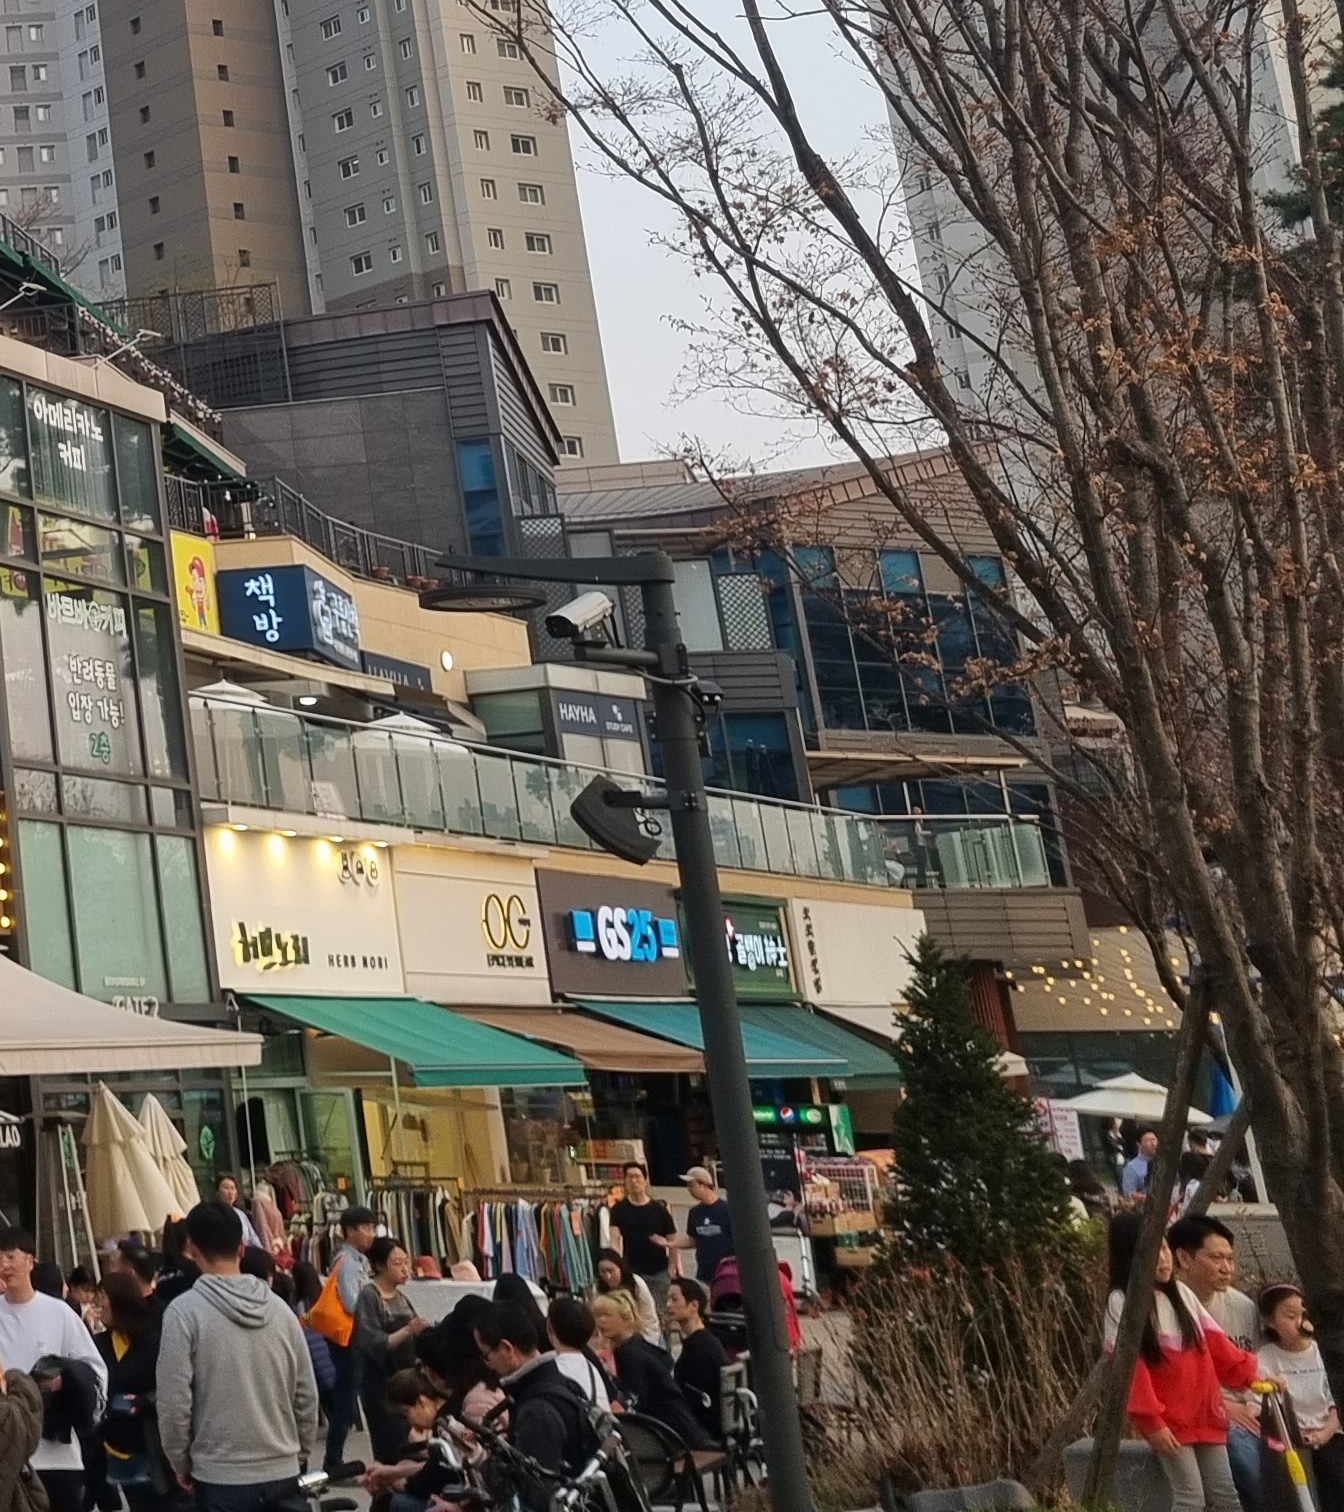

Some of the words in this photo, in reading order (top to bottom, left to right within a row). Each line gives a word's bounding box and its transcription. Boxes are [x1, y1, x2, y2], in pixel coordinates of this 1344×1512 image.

[33, 397, 104, 443] 아메리카노
[58, 442, 87, 472] 커피
[69, 654, 116, 691] 반려동물
[67, 692, 93, 723] 입장
[97, 698, 124, 729] 가능!
[559, 703, 597, 724] HAYHA
[90, 732, 111, 764] 2층
[598, 905, 658, 962] GS25
[328, 953, 356, 969] HERB
[363, 954, 388, 969] NORI
